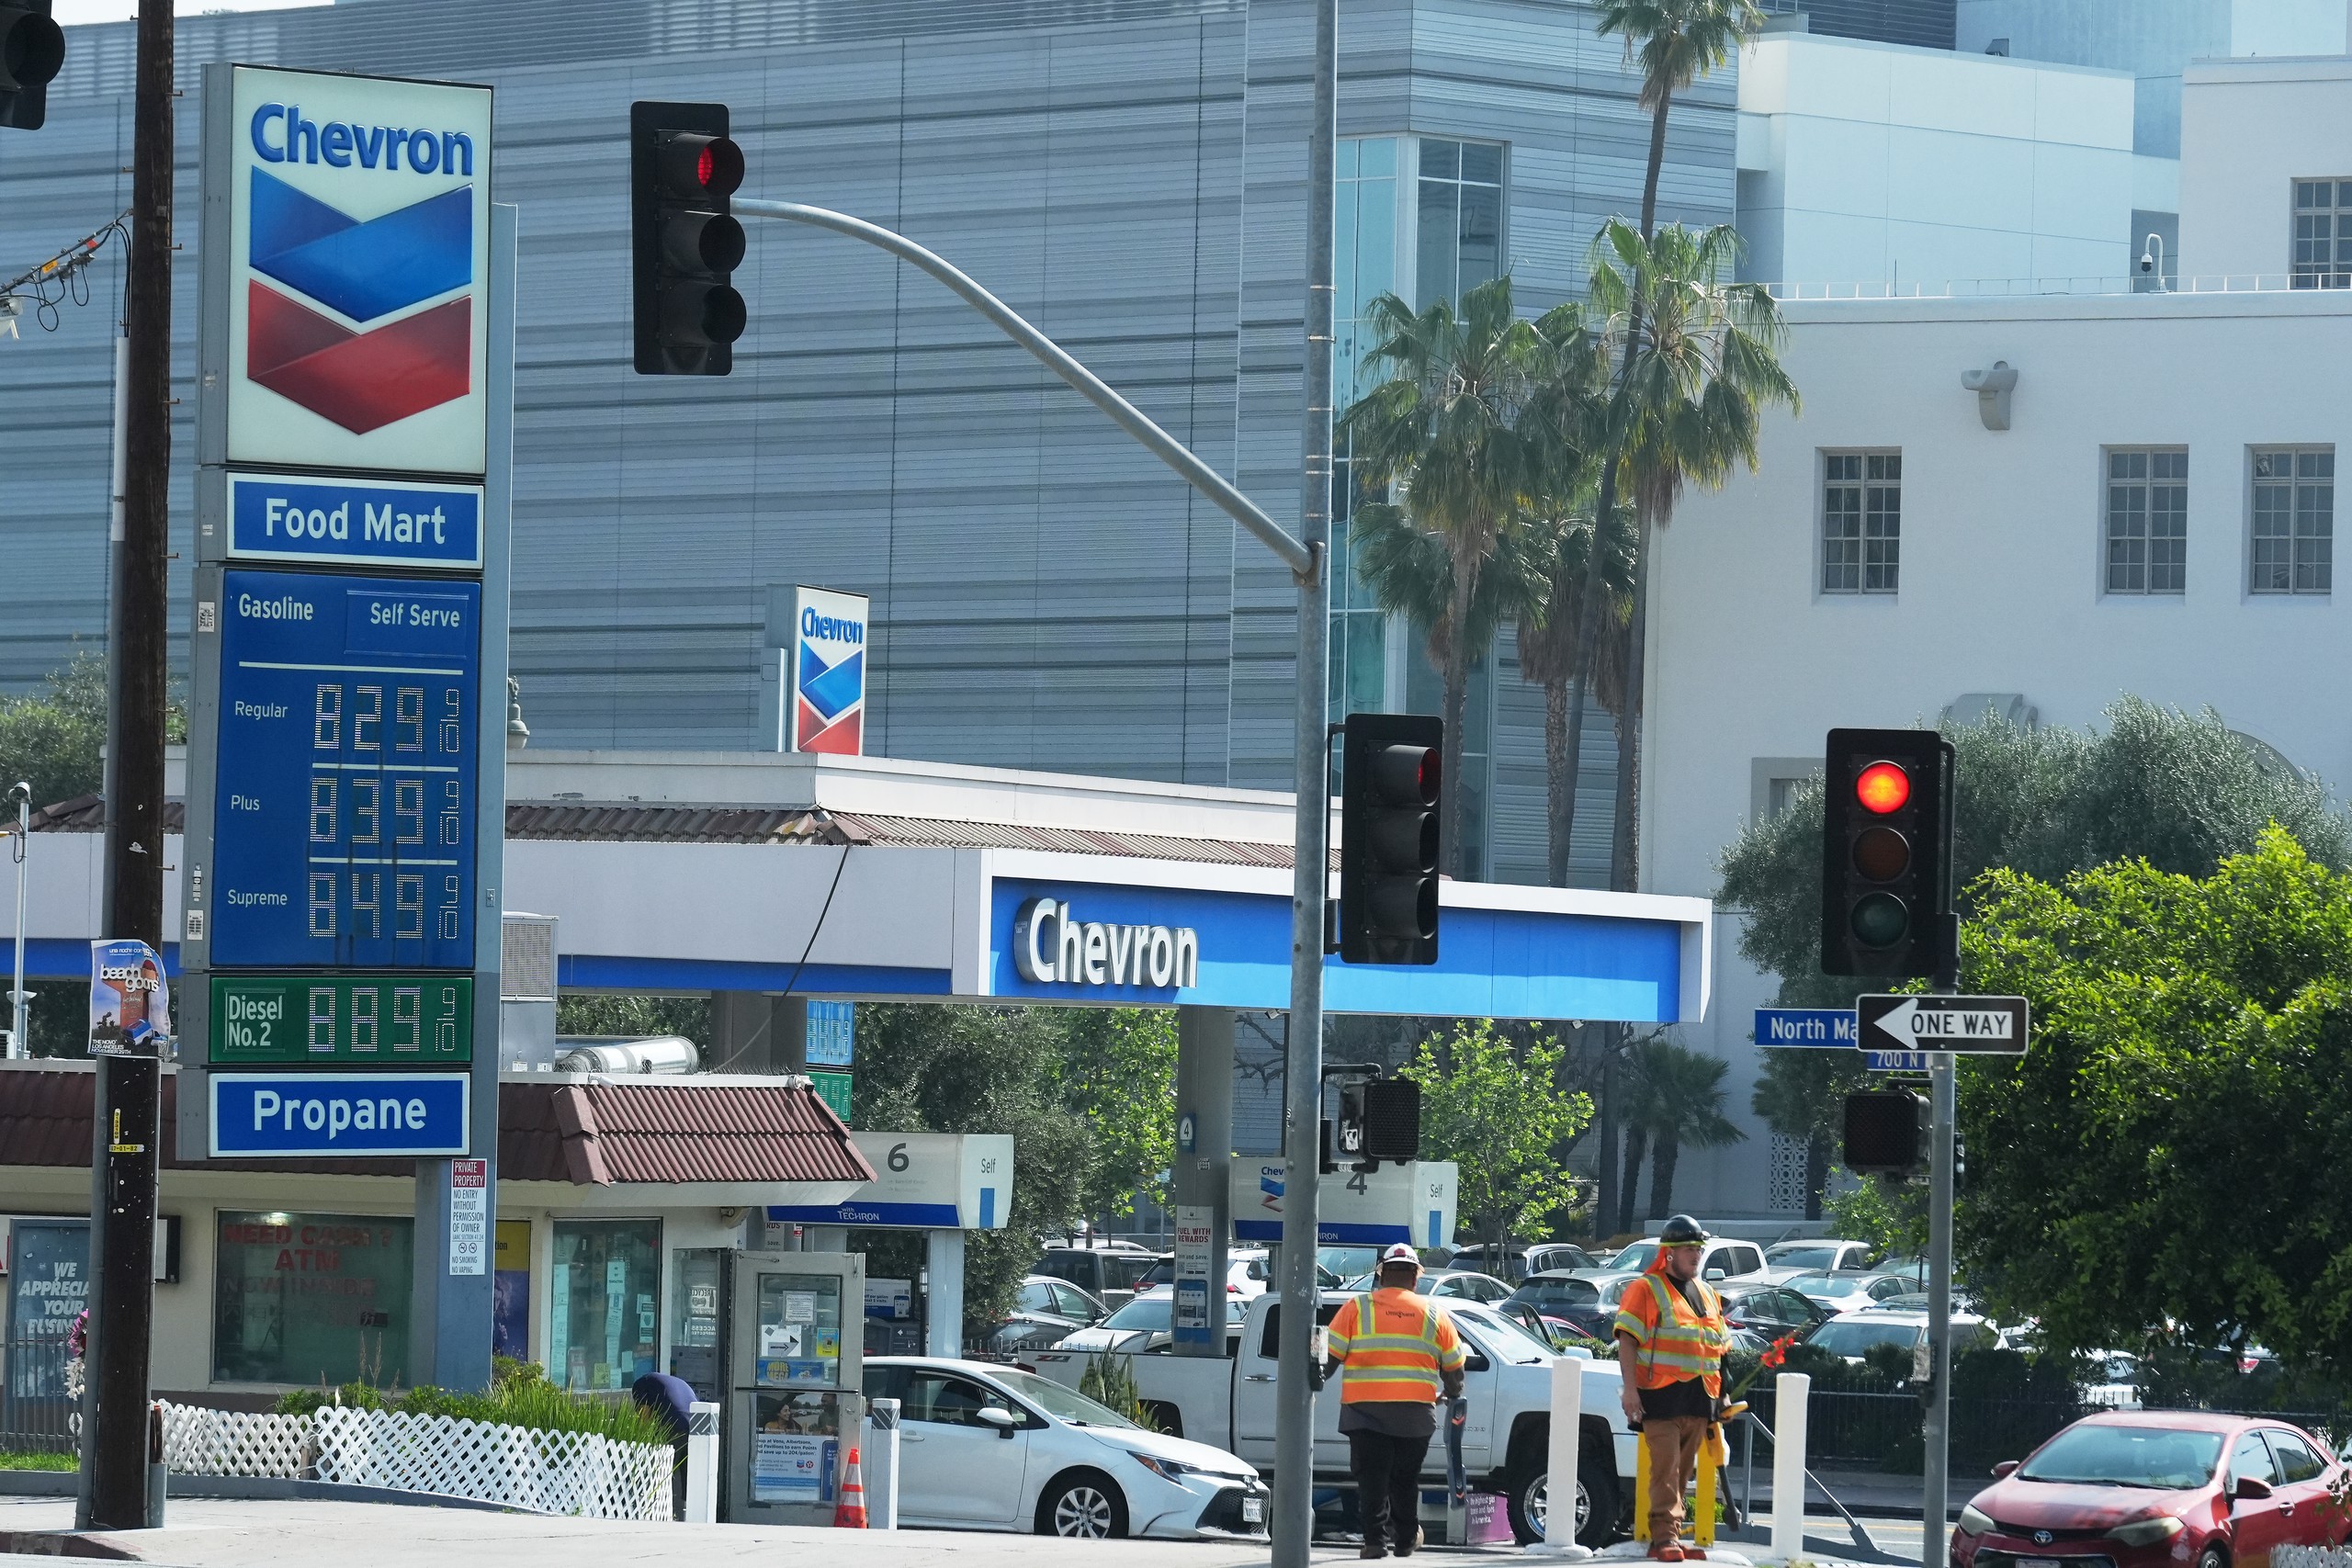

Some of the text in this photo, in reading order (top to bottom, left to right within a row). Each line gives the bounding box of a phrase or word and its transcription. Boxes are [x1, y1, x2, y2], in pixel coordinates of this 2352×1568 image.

[251, 102, 473, 176] Chevron
[266, 498, 446, 545] Food Mart
[239, 593, 460, 627] Gasoline Self Serve
[801, 605, 864, 645] Chevron
[234, 700, 288, 721] Regular
[314, 683, 424, 752] 829
[231, 795, 260, 811] Plus
[310, 777, 424, 844] 839
[227, 889, 288, 908] Supreme
[309, 873, 424, 939] 849
[1016, 897, 1199, 988] Chevron
[100, 963, 141, 980] beach
[229, 995, 283, 1021] Diesel
[309, 987, 421, 1052] 889
[1911, 1012, 2007, 1035] ONE WAY
[228, 1022, 256, 1046] No.
[260, 1021, 271, 1046] 2
[1770, 1017, 1826, 1040] North
[1876, 1052, 1918, 1068] 700 N
[254, 1089, 427, 1141] Propane
[1183, 1122, 1190, 1138] 4
[888, 1143, 910, 1173] 6
[980, 1157, 997, 1174] Self
[454, 1161, 478, 1173] PRIVATE
[1261, 1166, 1284, 1176] Chev
[454, 1175, 484, 1187] PROPERTY
[1346, 1171, 1368, 1195] 4
[453, 1189, 478, 1199] NO ENTRY
[1430, 1183, 1443, 1198] Self
[453, 1201, 477, 1211] WITHOUT
[453, 1212, 484, 1222] PERMISSION
[837, 1211, 880, 1222] TECHRON
[223, 1224, 293, 1245] NEED
[452, 1223, 480, 1232] OF OWNER
[1177, 1226, 1211, 1235] FUEL WITH
[1178, 1235, 1209, 1243] REWARDS
[274, 1248, 342, 1271] ATM
[451, 1256, 478, 1264] NO SMOKING
[54, 1262, 77, 1278] WE
[451, 1266, 458, 1274] NO
[44, 1300, 85, 1315] YOUR
